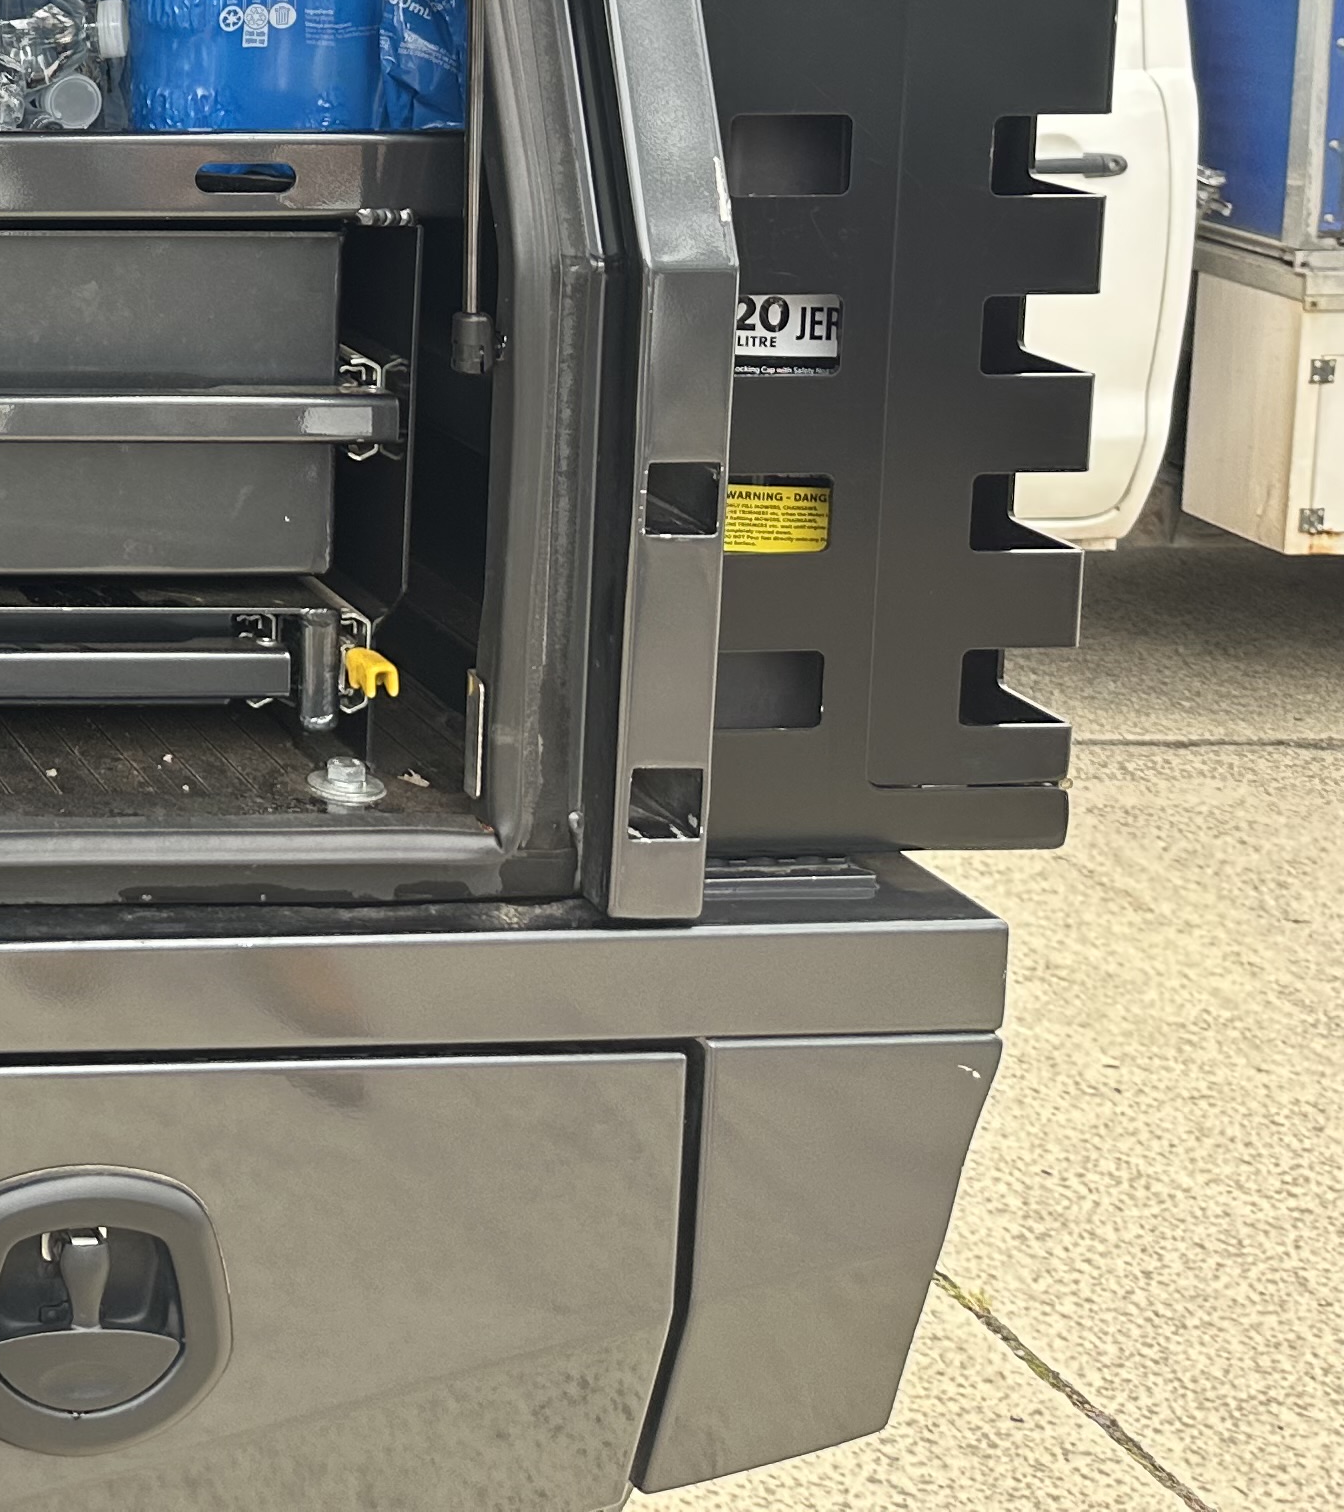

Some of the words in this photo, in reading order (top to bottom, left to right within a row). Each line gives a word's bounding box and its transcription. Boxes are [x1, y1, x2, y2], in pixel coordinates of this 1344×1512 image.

[736, 295, 790, 333] 20
[737, 335, 777, 348] LITRE
[727, 490, 783, 502] WARNING
[794, 493, 827, 502] DANG
